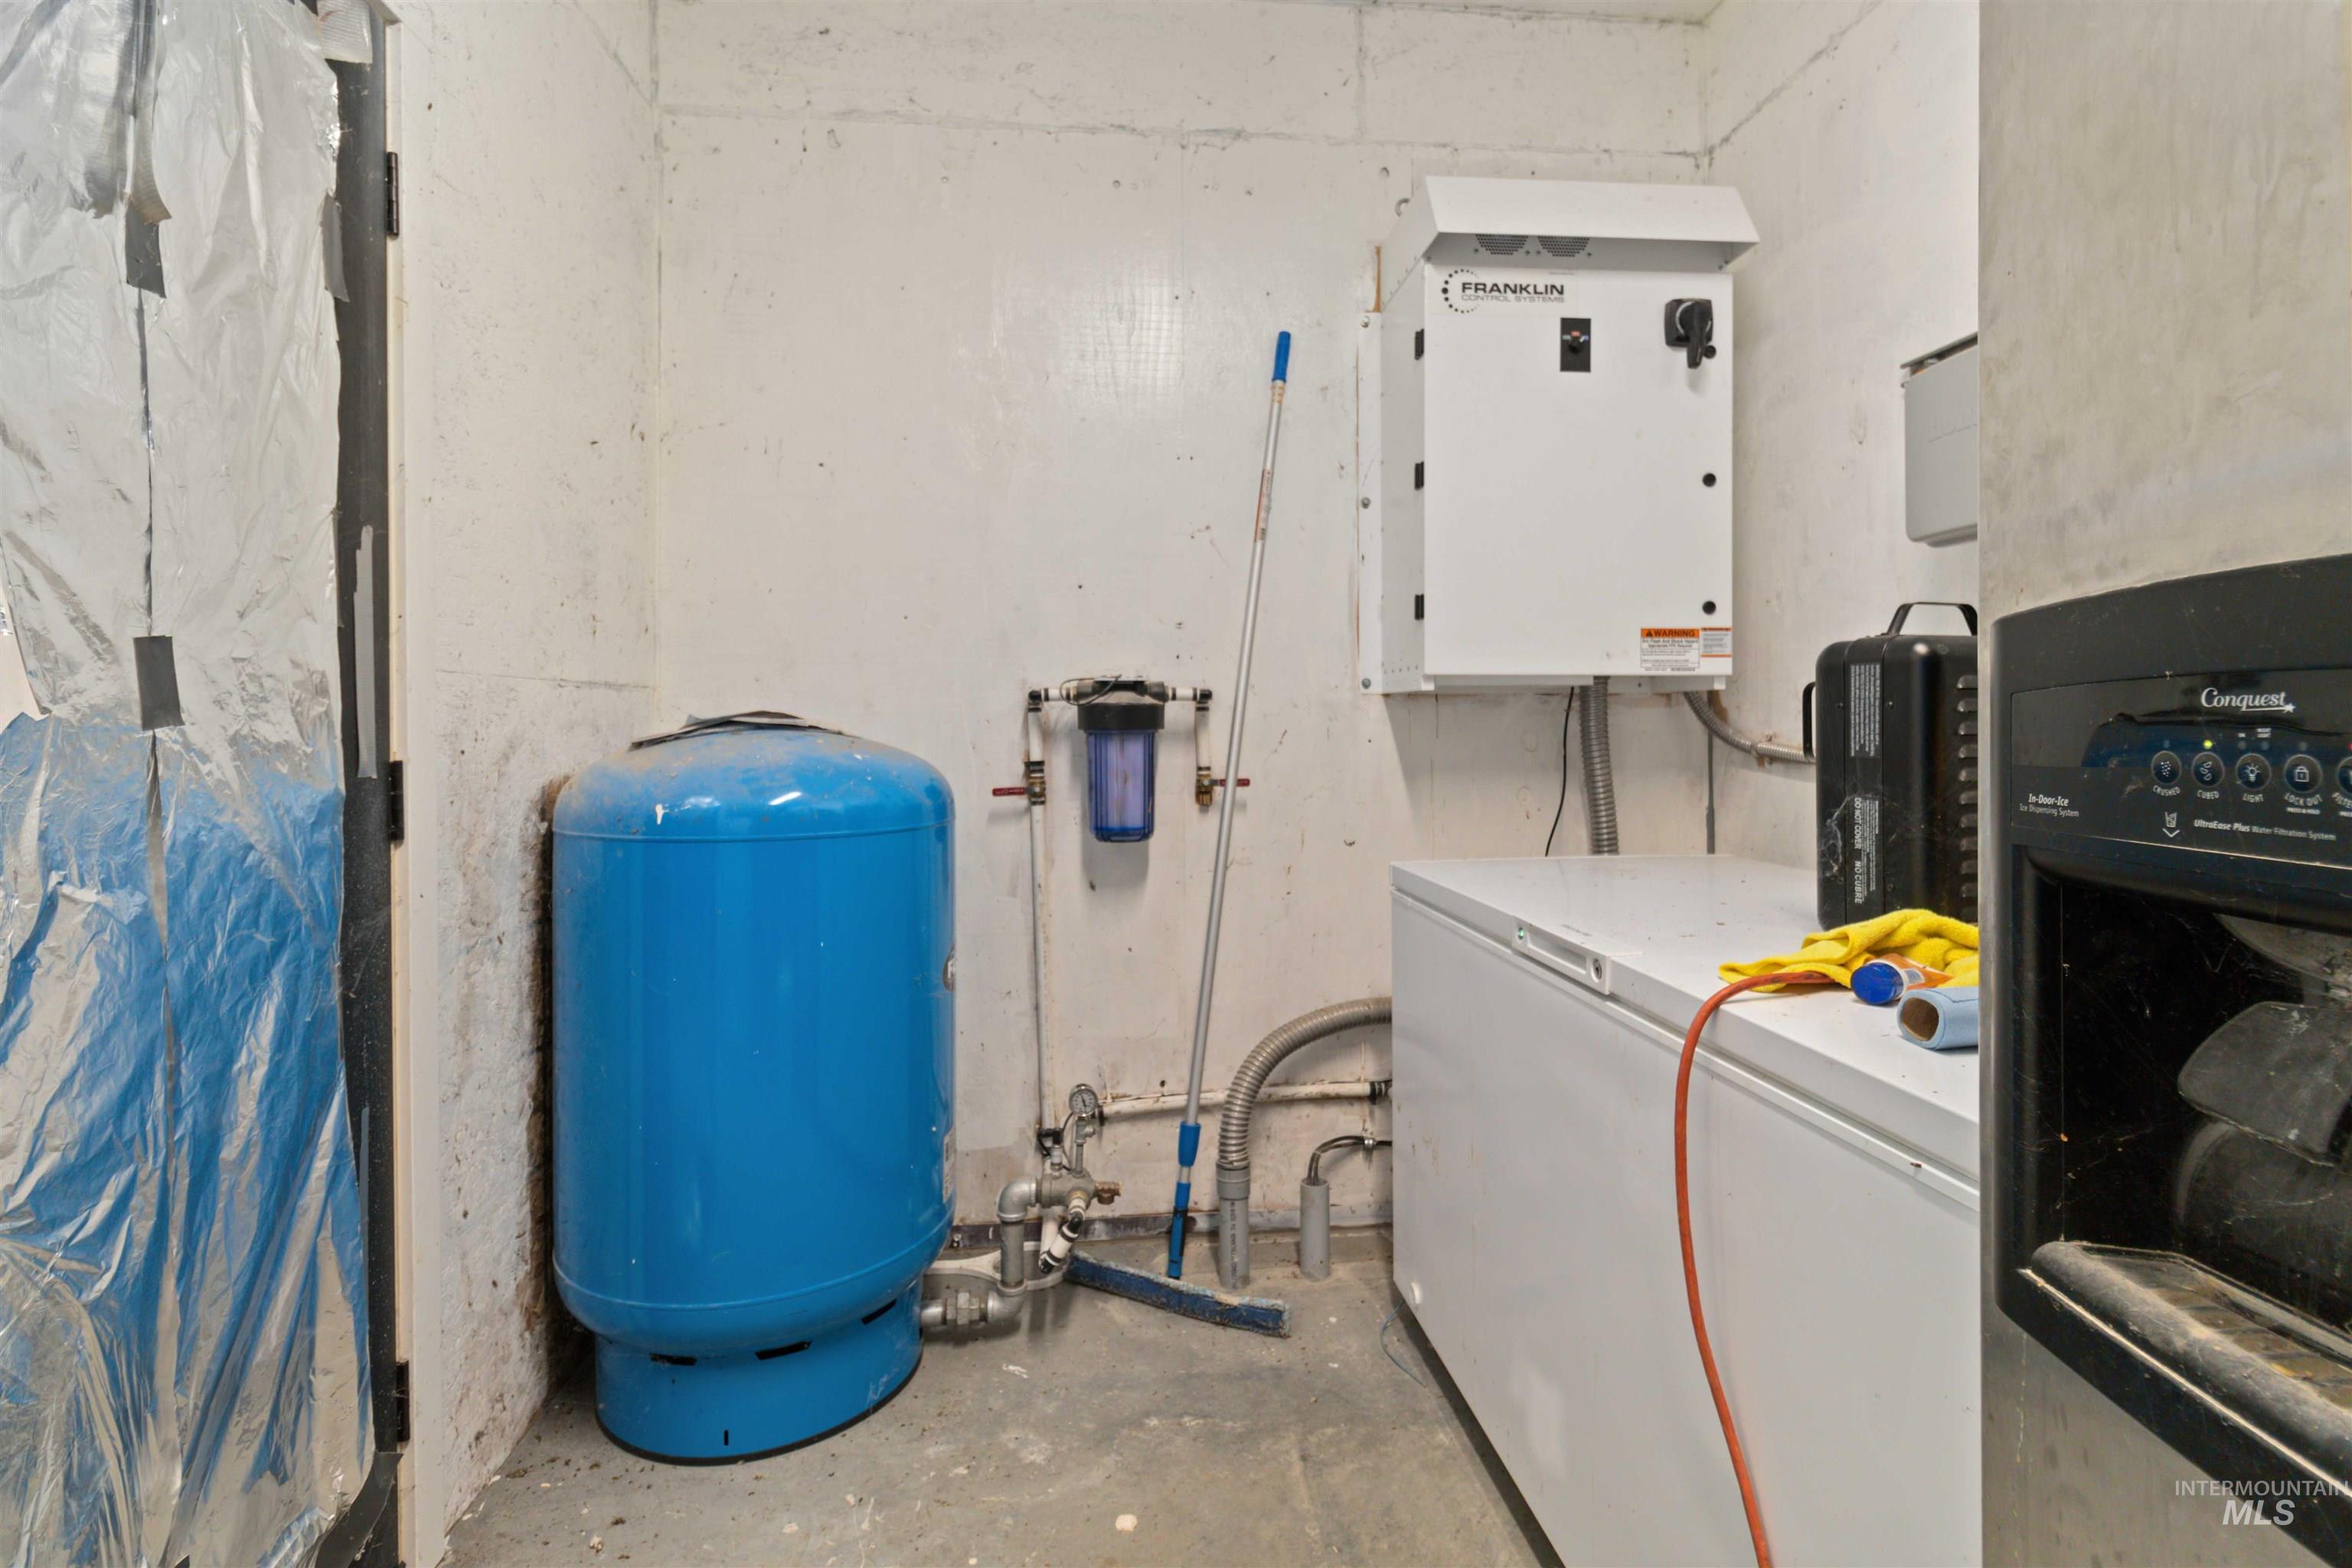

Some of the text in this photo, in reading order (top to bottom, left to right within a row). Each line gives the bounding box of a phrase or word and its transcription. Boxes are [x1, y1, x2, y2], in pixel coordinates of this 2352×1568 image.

[1462, 282, 1564, 296] FRANKLIN
[1461, 294, 1511, 302] CONTROL
[2201, 688, 2288, 710] Conquest
[2152, 785, 2180, 796] CRUSHED
[2197, 789, 2220, 799] CUBED
[1854, 797, 1862, 808] DO
[2028, 793, 2069, 806] In-Door-Ice
[2242, 793, 2264, 802] LIGHT
[2284, 792, 2323, 806] LOCK OUT
[2020, 803, 2079, 817] Ice Dispensing System
[2194, 818, 2336, 841] UltraEase Plus Water Filtration System
[1854, 861, 1863, 903] NO CUBRE
